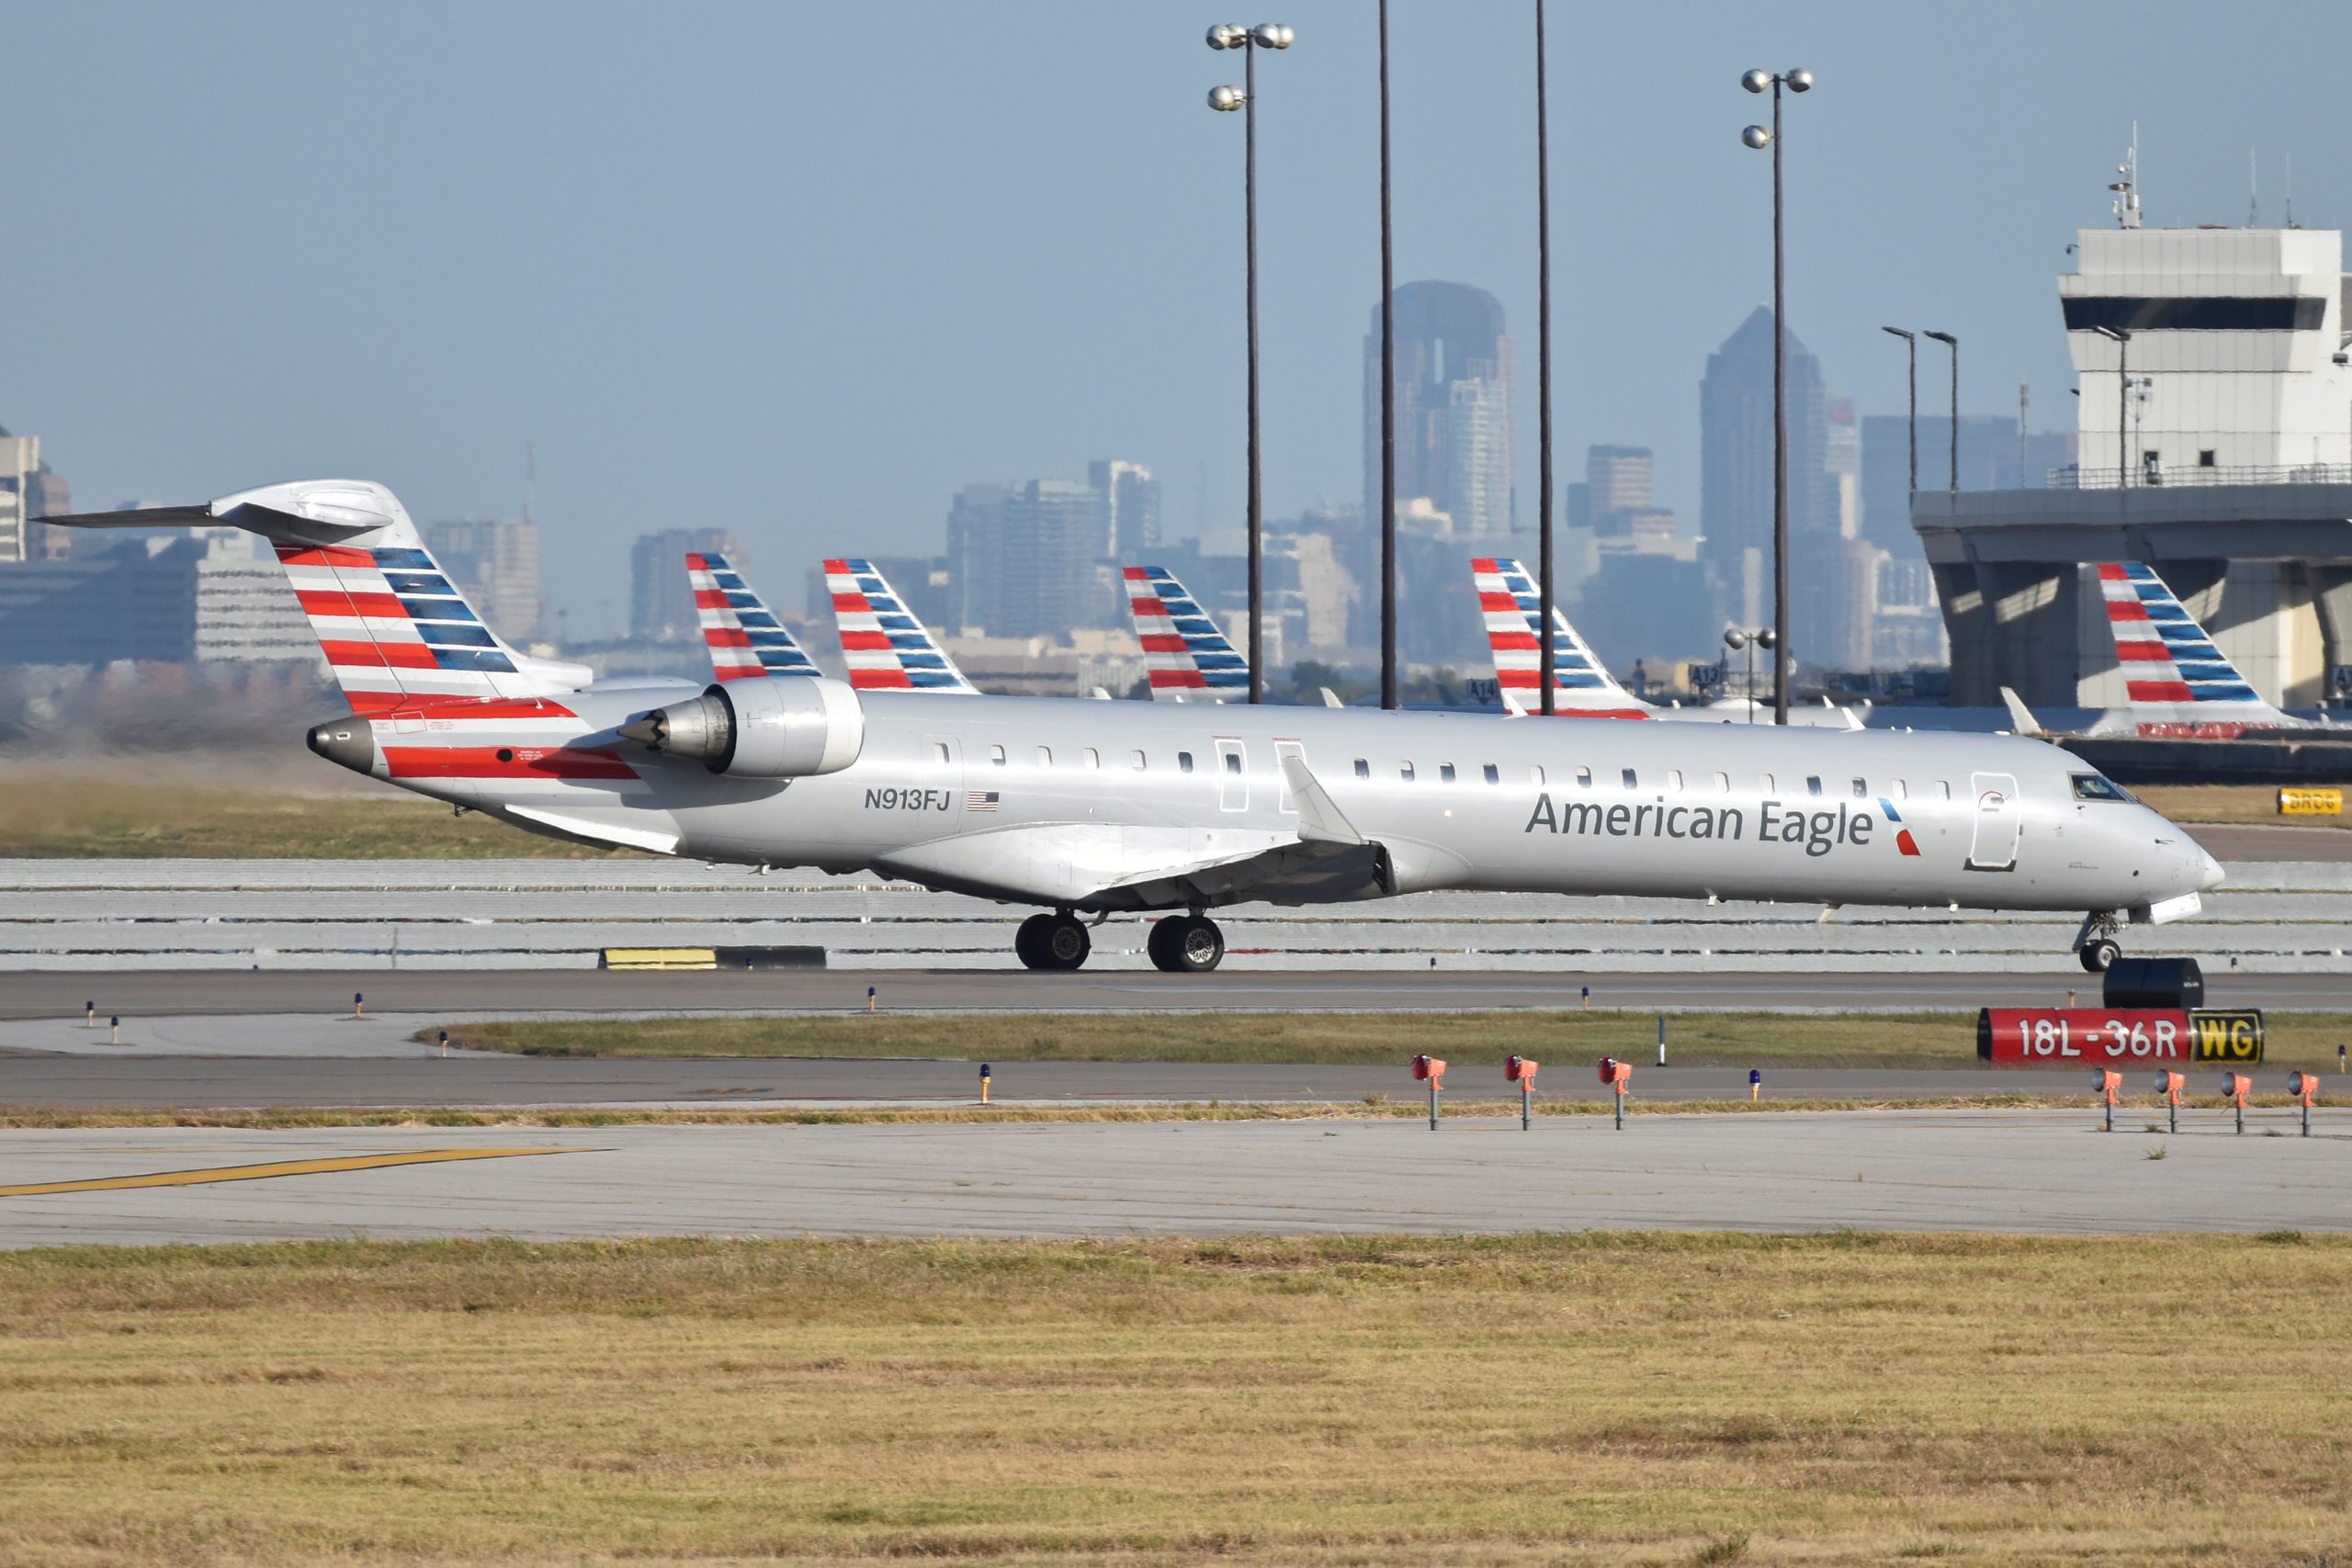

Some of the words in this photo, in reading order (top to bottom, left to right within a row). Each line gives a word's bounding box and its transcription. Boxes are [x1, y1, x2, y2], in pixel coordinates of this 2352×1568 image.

[1691, 667, 1718, 682] A13
[865, 788, 951, 811] N913FJ
[1524, 793, 1744, 840] American
[1758, 801, 1873, 857] Eagle
[2019, 1019, 2177, 1057] 18L-36R
[2199, 1019, 2252, 1056] WG
